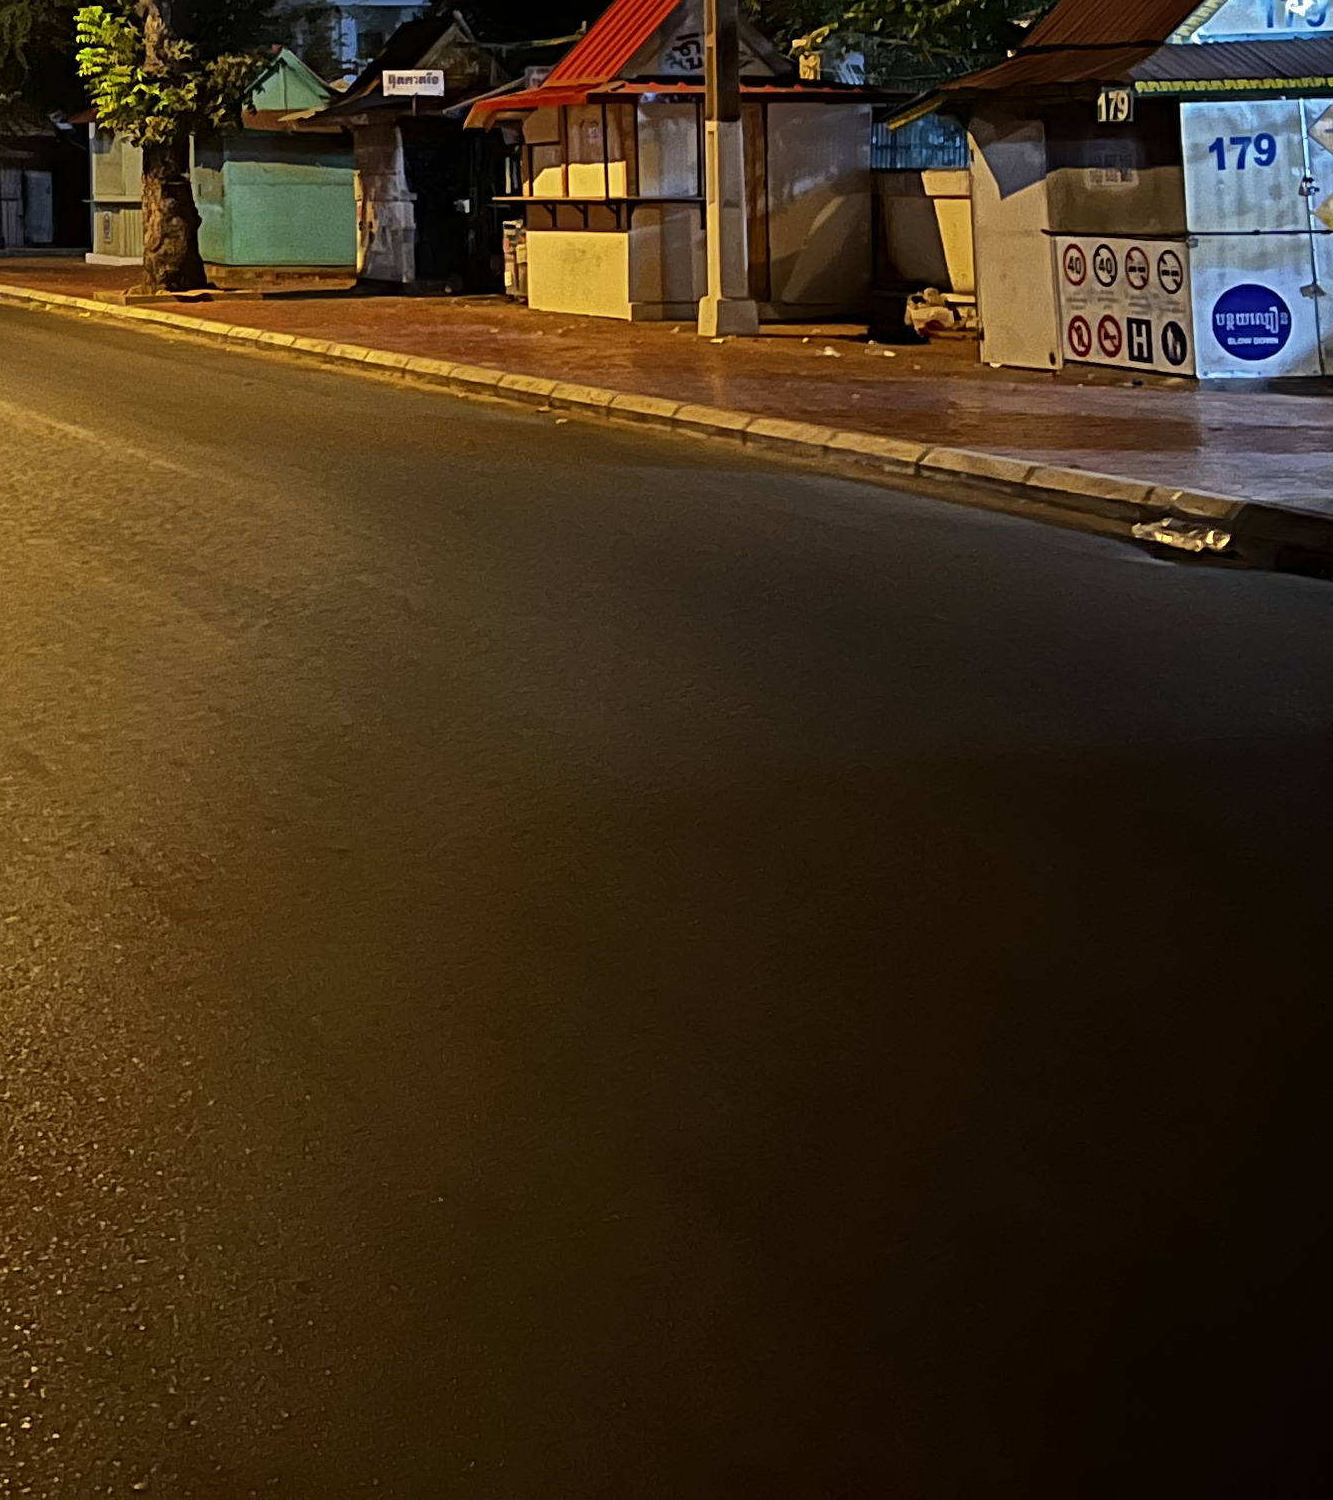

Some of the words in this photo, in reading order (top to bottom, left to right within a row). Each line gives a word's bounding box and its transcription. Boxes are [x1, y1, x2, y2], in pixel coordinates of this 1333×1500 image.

[1097, 91, 1129, 122] 179
[1208, 133, 1277, 171] 179
[1067, 255, 1082, 275] 40
[1098, 257, 1113, 276] 40
